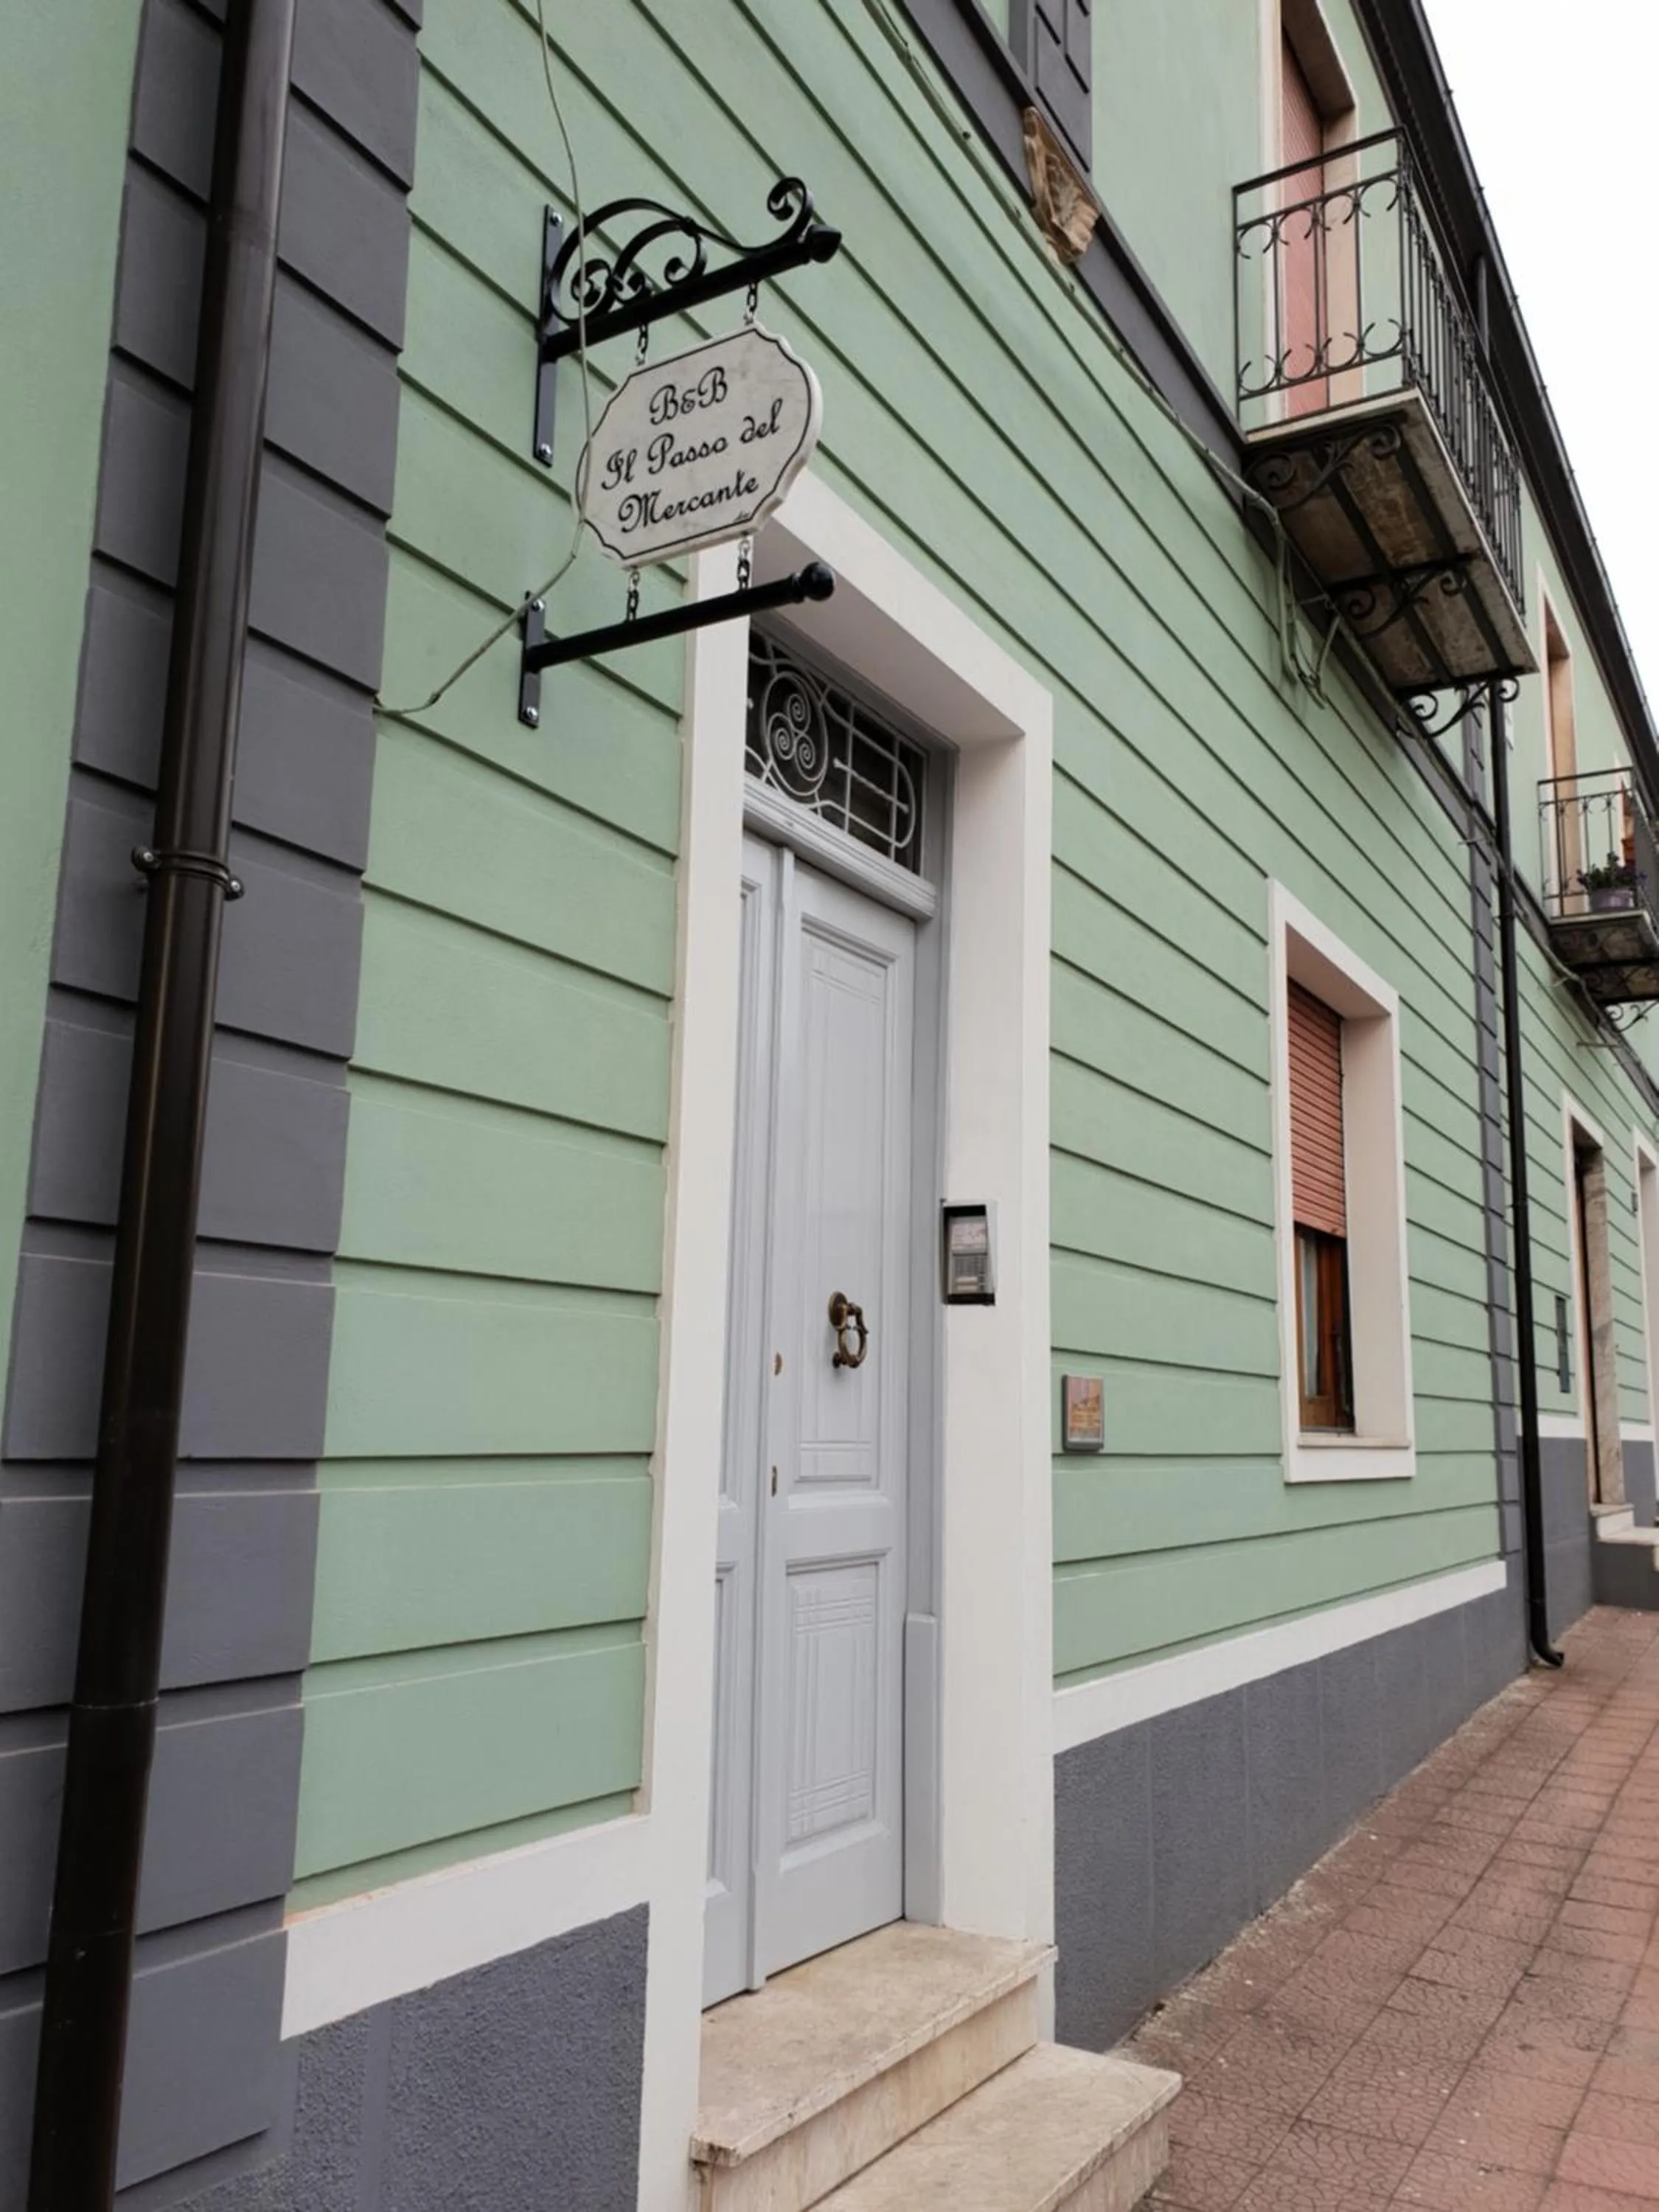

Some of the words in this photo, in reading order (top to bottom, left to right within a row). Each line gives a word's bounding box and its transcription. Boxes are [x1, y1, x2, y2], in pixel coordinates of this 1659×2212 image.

[650, 366, 728, 425] B&B
[601, 448, 637, 490] Il
[647, 433, 728, 475] Passo
[740, 398, 783, 444] del
[618, 469, 759, 533] Mercante
